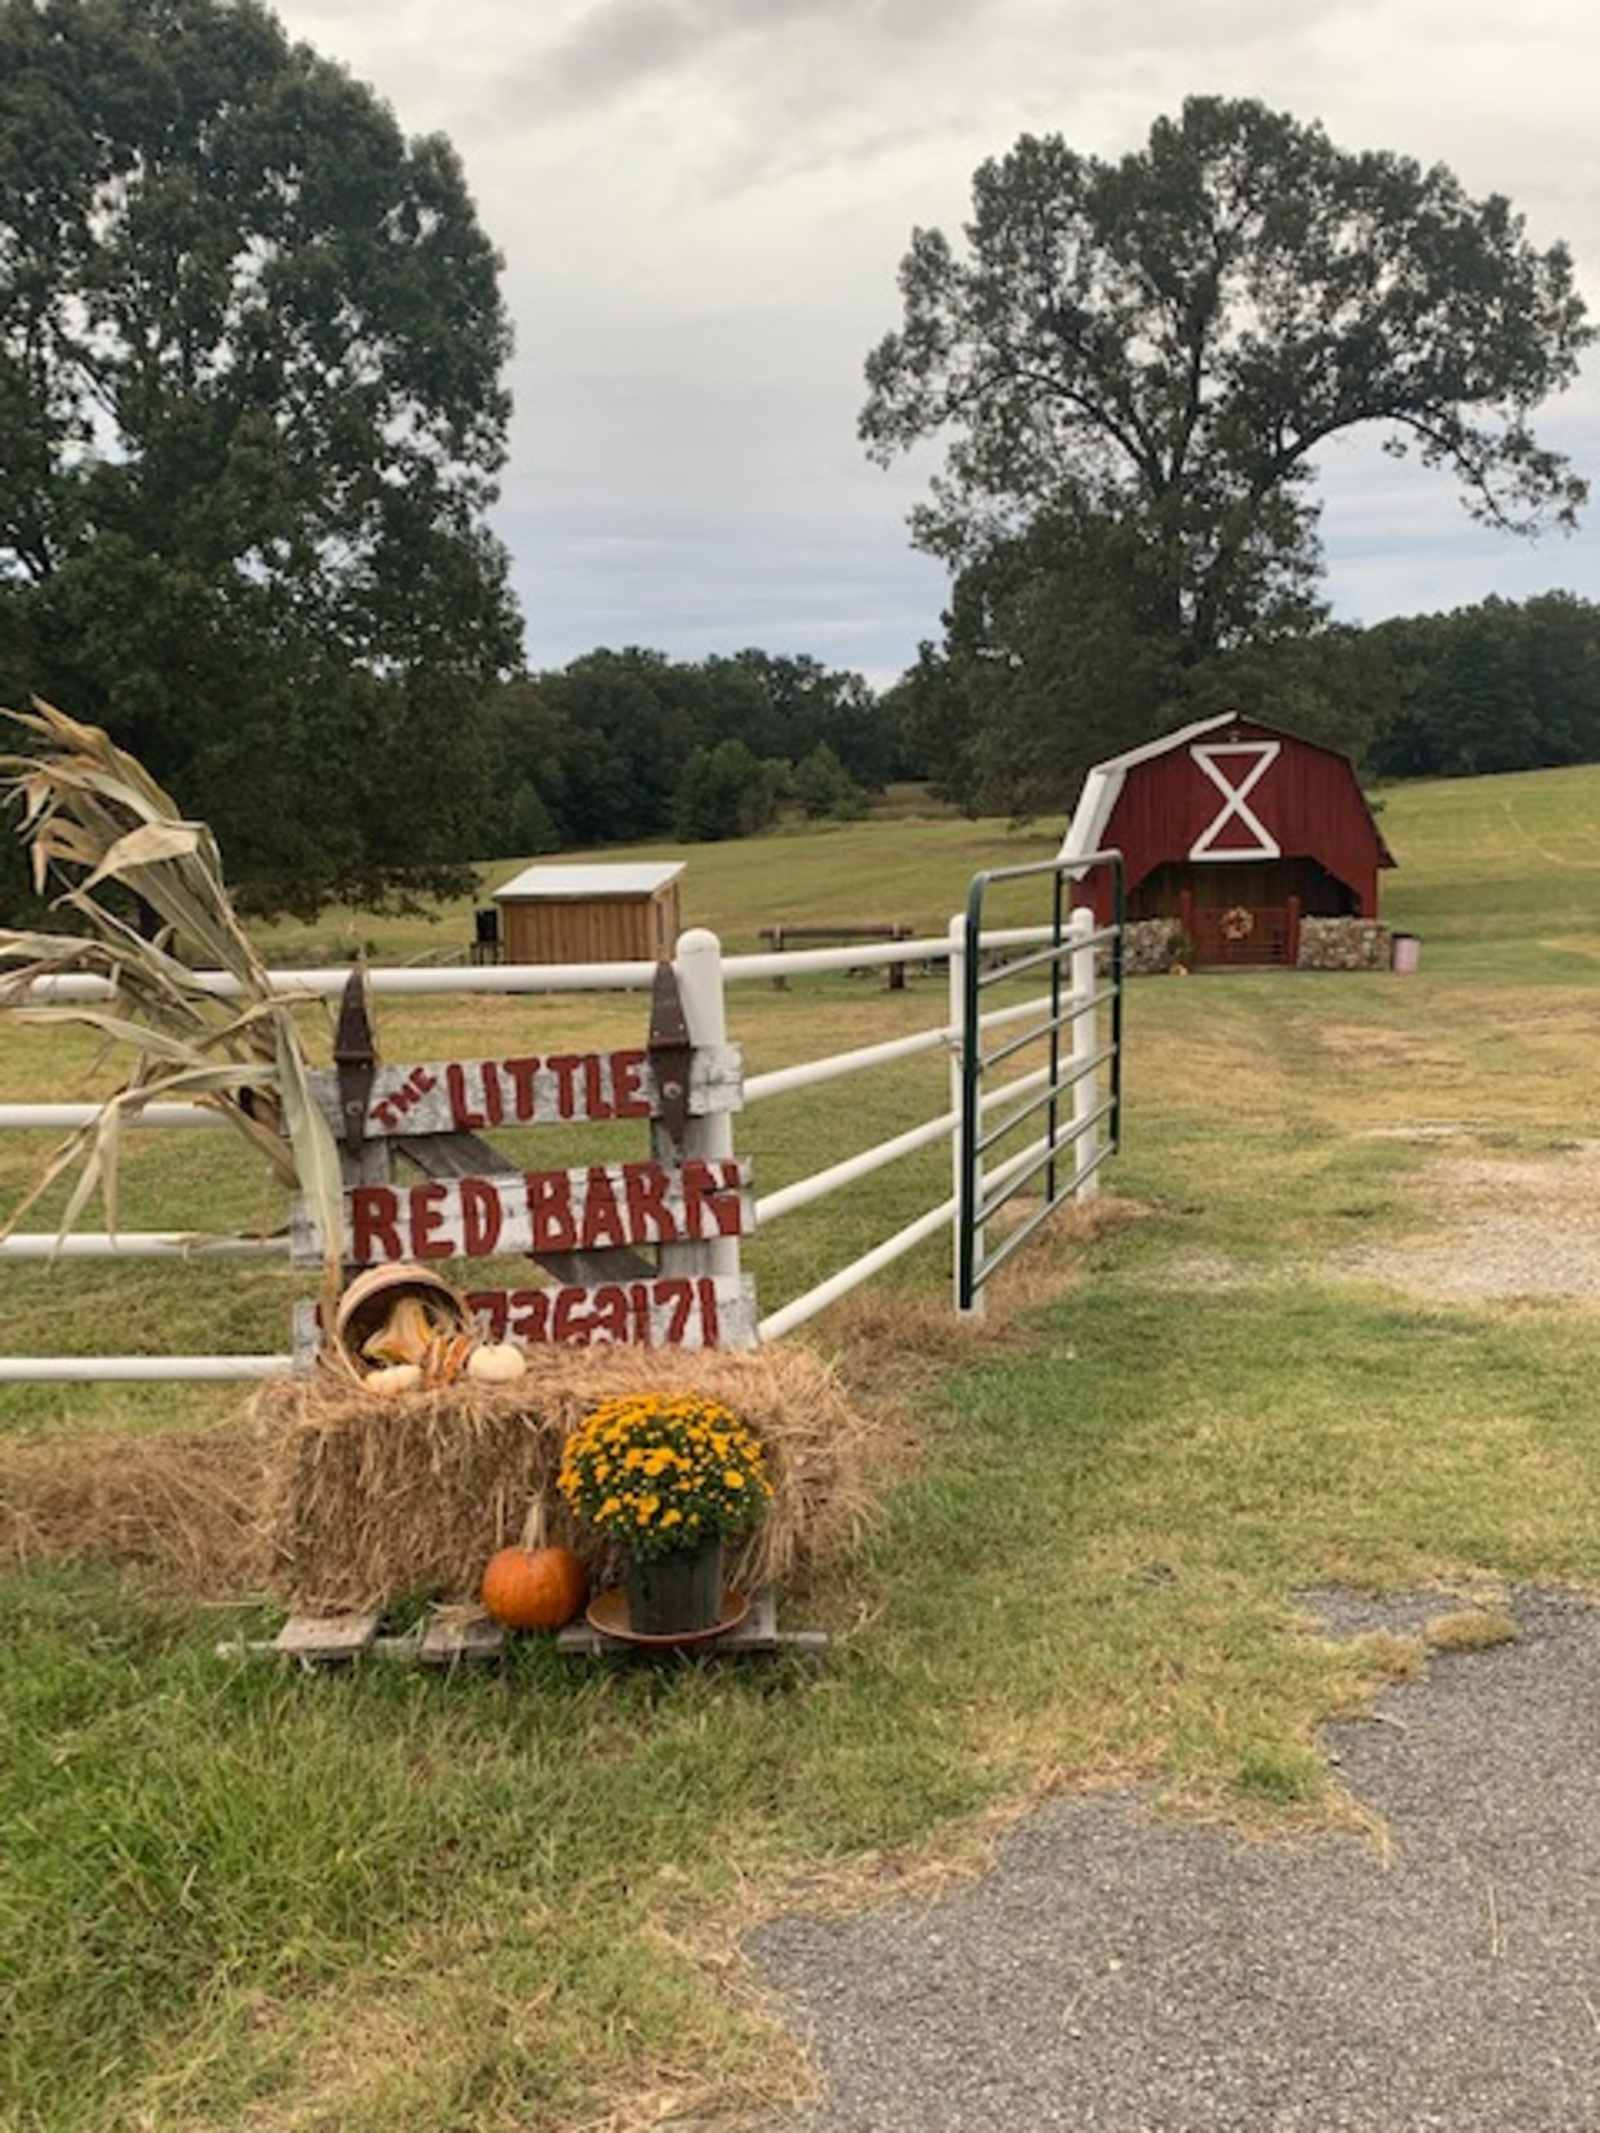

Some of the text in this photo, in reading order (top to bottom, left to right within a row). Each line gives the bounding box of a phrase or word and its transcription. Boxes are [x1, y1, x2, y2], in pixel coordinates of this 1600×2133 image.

[369, 1050, 651, 1130] THE LITTLE
[351, 1160, 742, 1264] RED BARN
